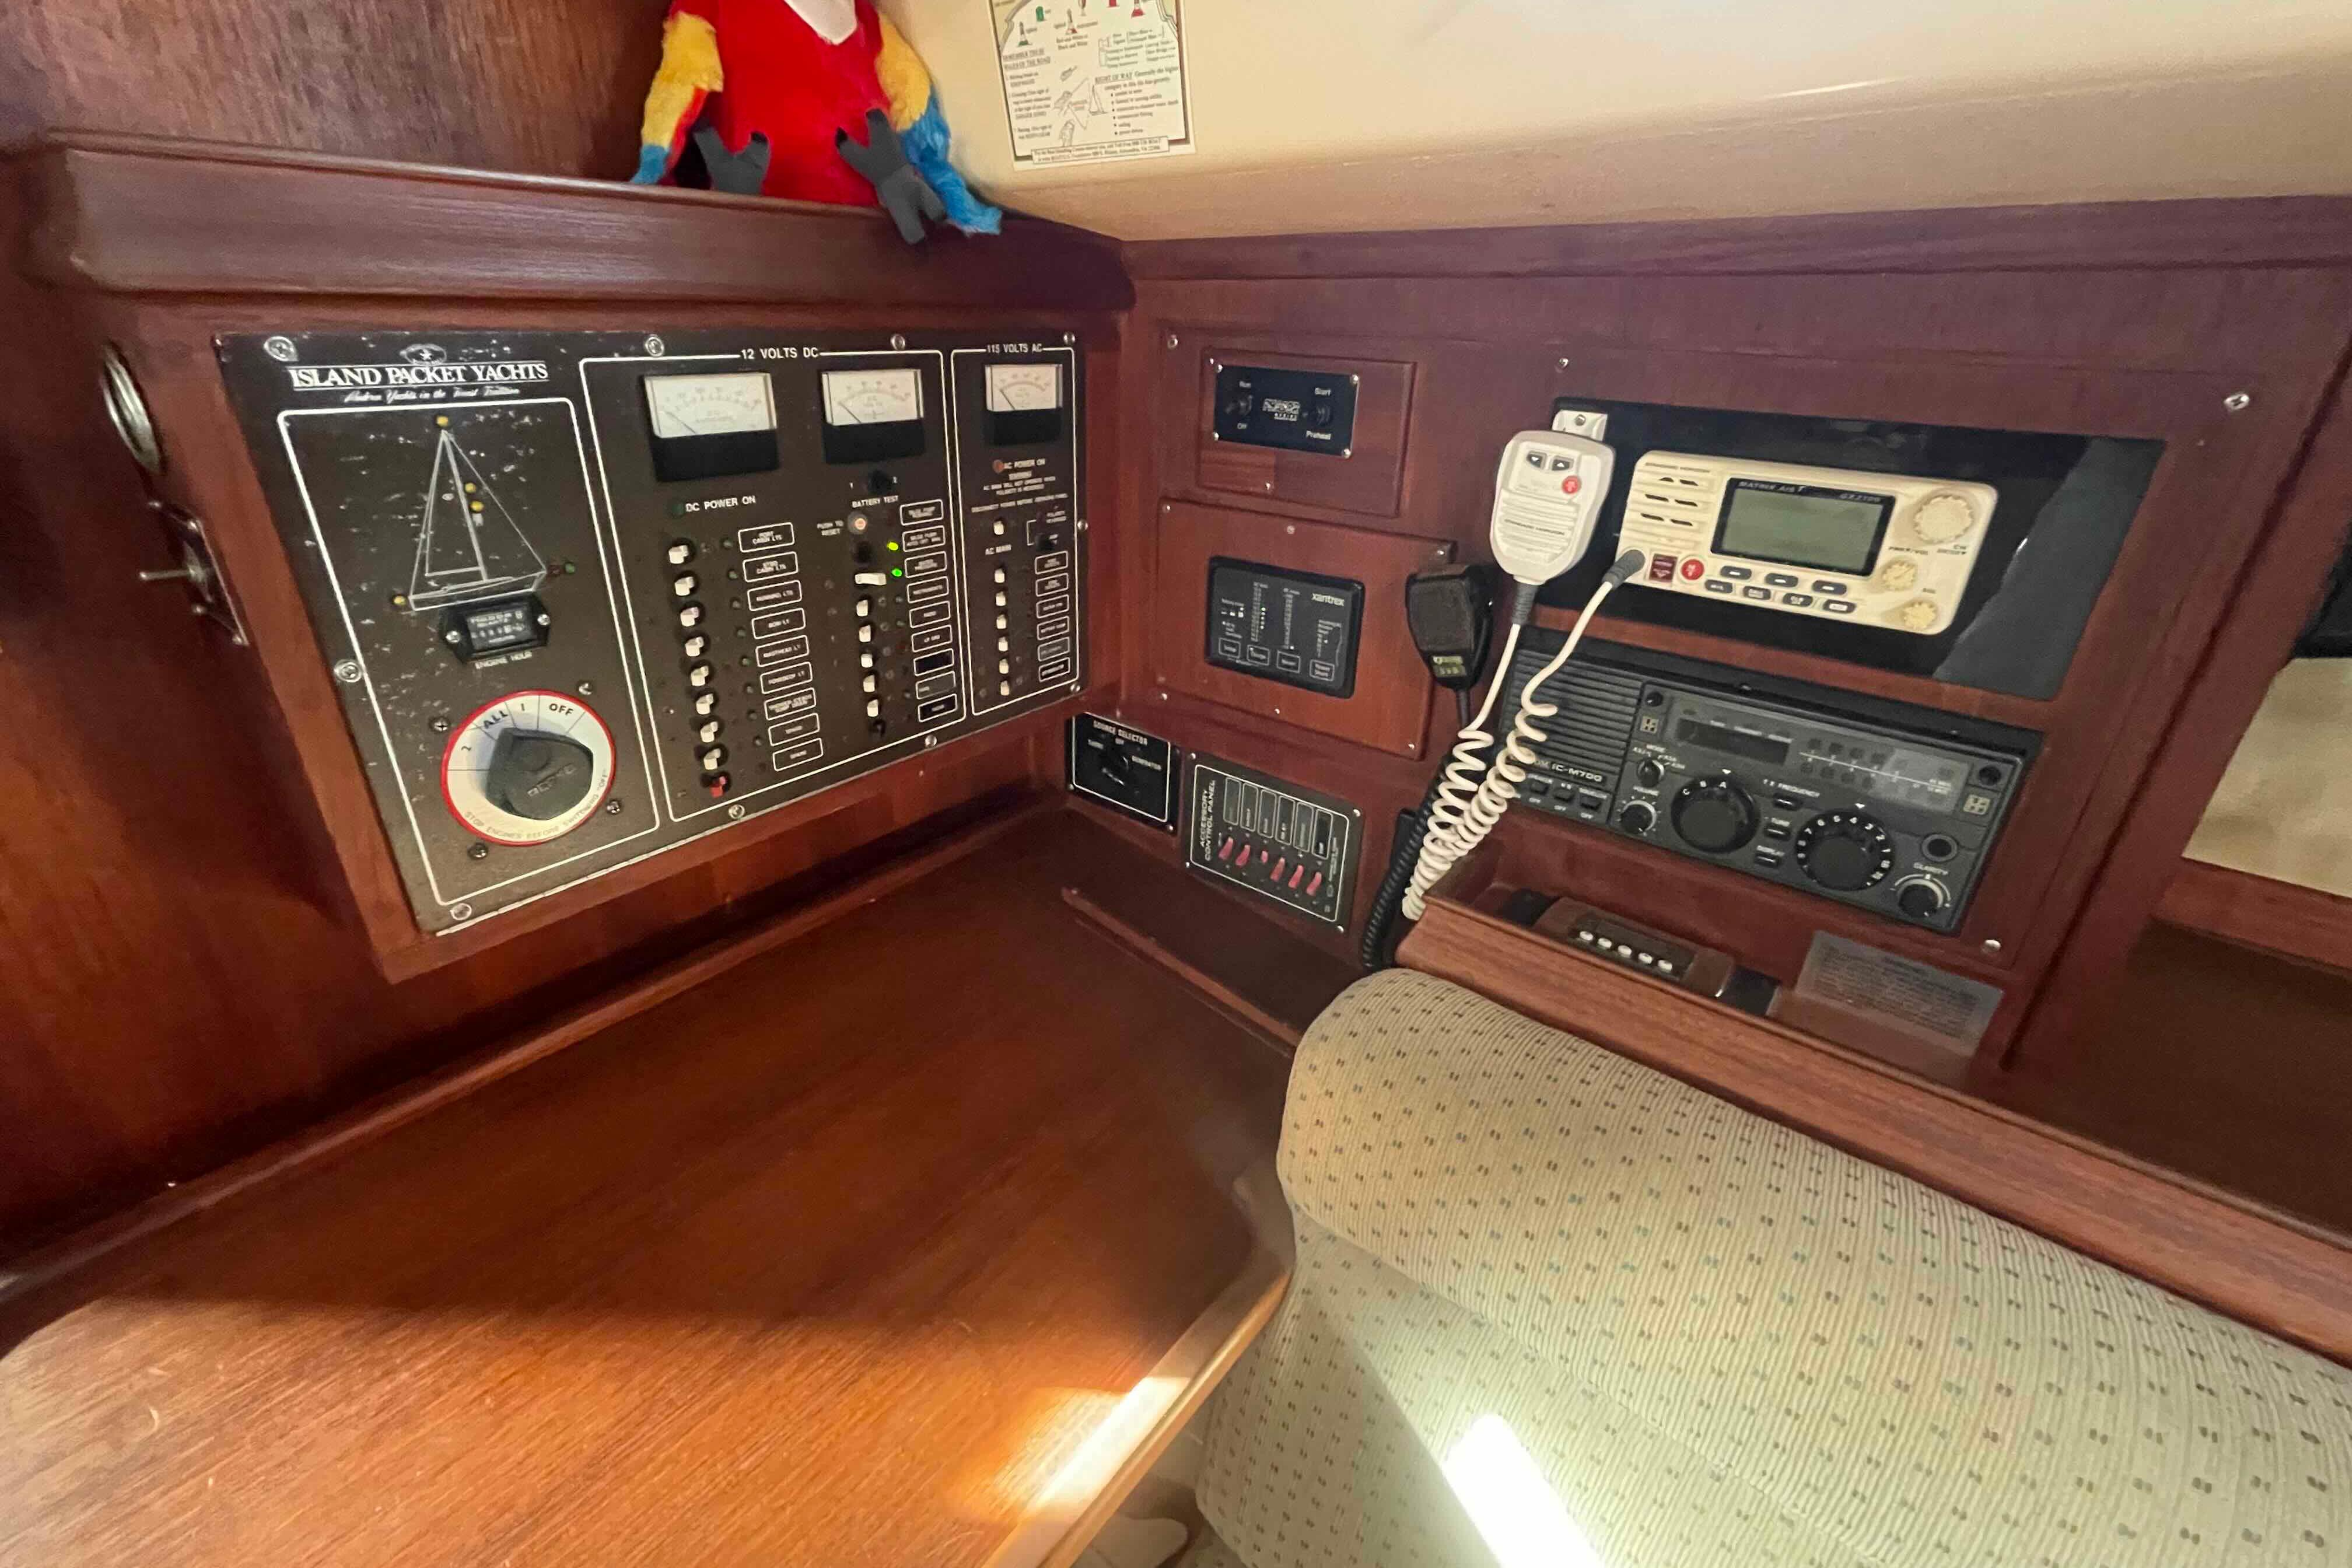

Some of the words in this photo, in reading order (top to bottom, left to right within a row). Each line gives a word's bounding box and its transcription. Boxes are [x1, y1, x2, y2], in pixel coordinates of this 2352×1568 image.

[741, 349, 755, 360] 12
[760, 348, 797, 359] VOLTS
[803, 348, 820, 359] DC
[987, 344, 1000, 354] 115
[1003, 343, 1028, 353] VOLTS
[1032, 343, 1043, 352] AC
[289, 367, 382, 388] ISLAND
[386, 365, 467, 385] PACKET
[468, 363, 549, 382] YACHTS
[685, 502, 700, 512] DC
[704, 497, 738, 510] POWER
[742, 495, 756, 505] ON
[852, 498, 881, 508] BATTERY
[883, 495, 900, 503] TEST
[1311, 593, 1345, 607] xantrex
[475, 656, 508, 670] ENGINE
[548, 702, 574, 717] OFF
[483, 709, 509, 729] ALL
[1552, 763, 1603, 782] IC-M700
[1208, 780, 1216, 813] PANEL
[1205, 816, 1213, 861] CONTROL
